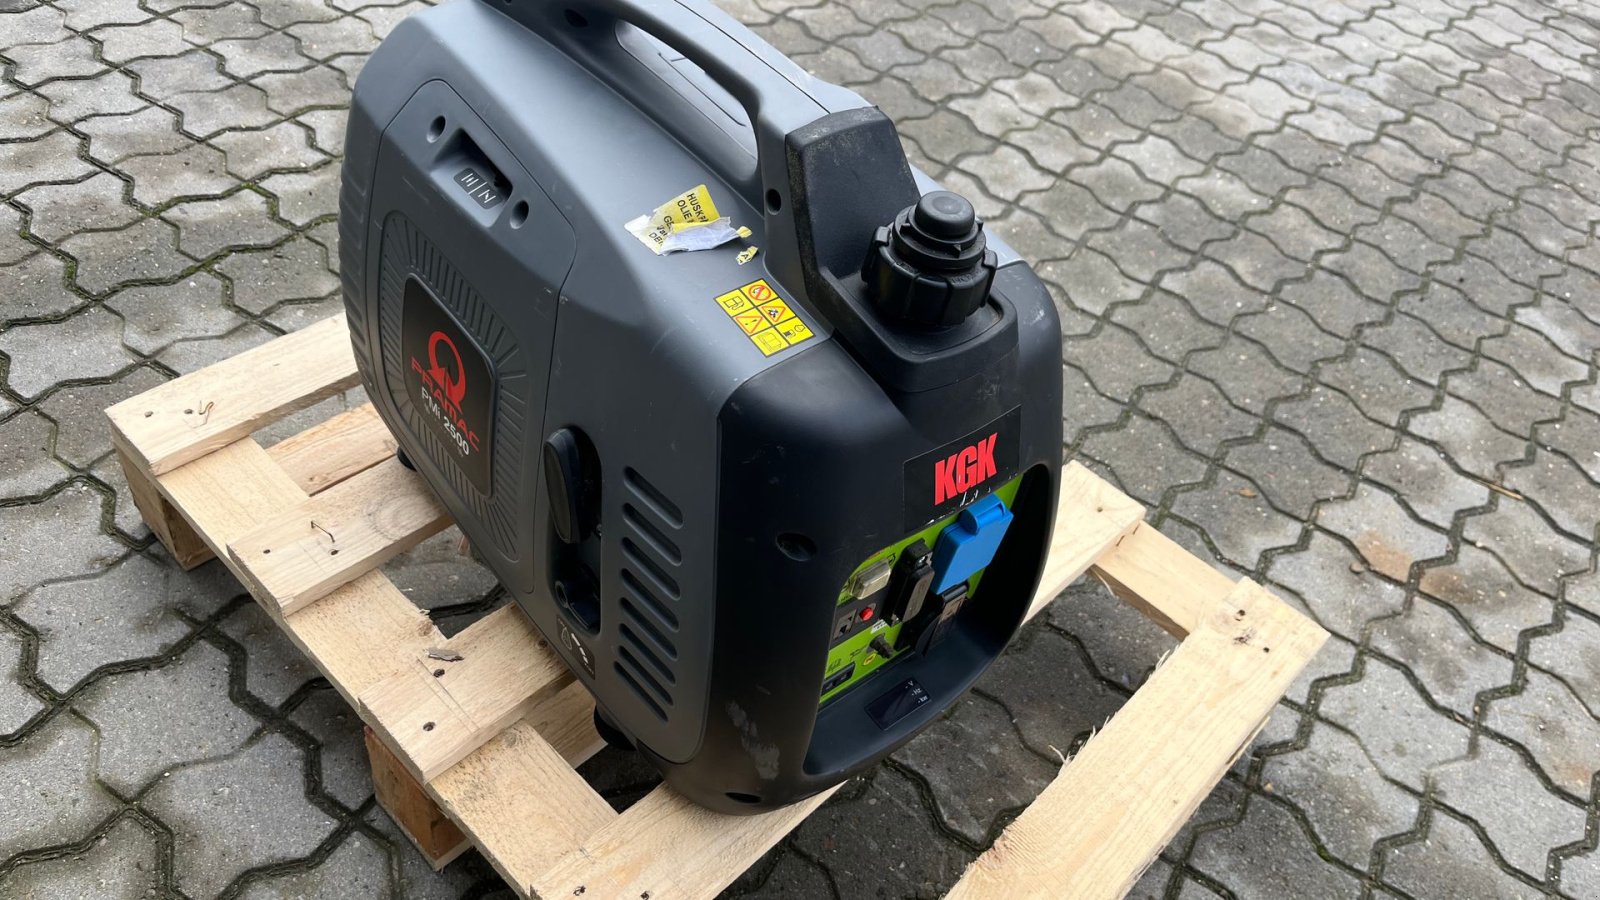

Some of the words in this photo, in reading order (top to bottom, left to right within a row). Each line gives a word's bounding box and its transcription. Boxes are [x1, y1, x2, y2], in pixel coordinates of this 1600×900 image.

[677, 199, 693, 220] OLIE
[411, 356, 480, 453] PRAMAC
[443, 416, 469, 456] 2500
[934, 432, 998, 505] KGK
